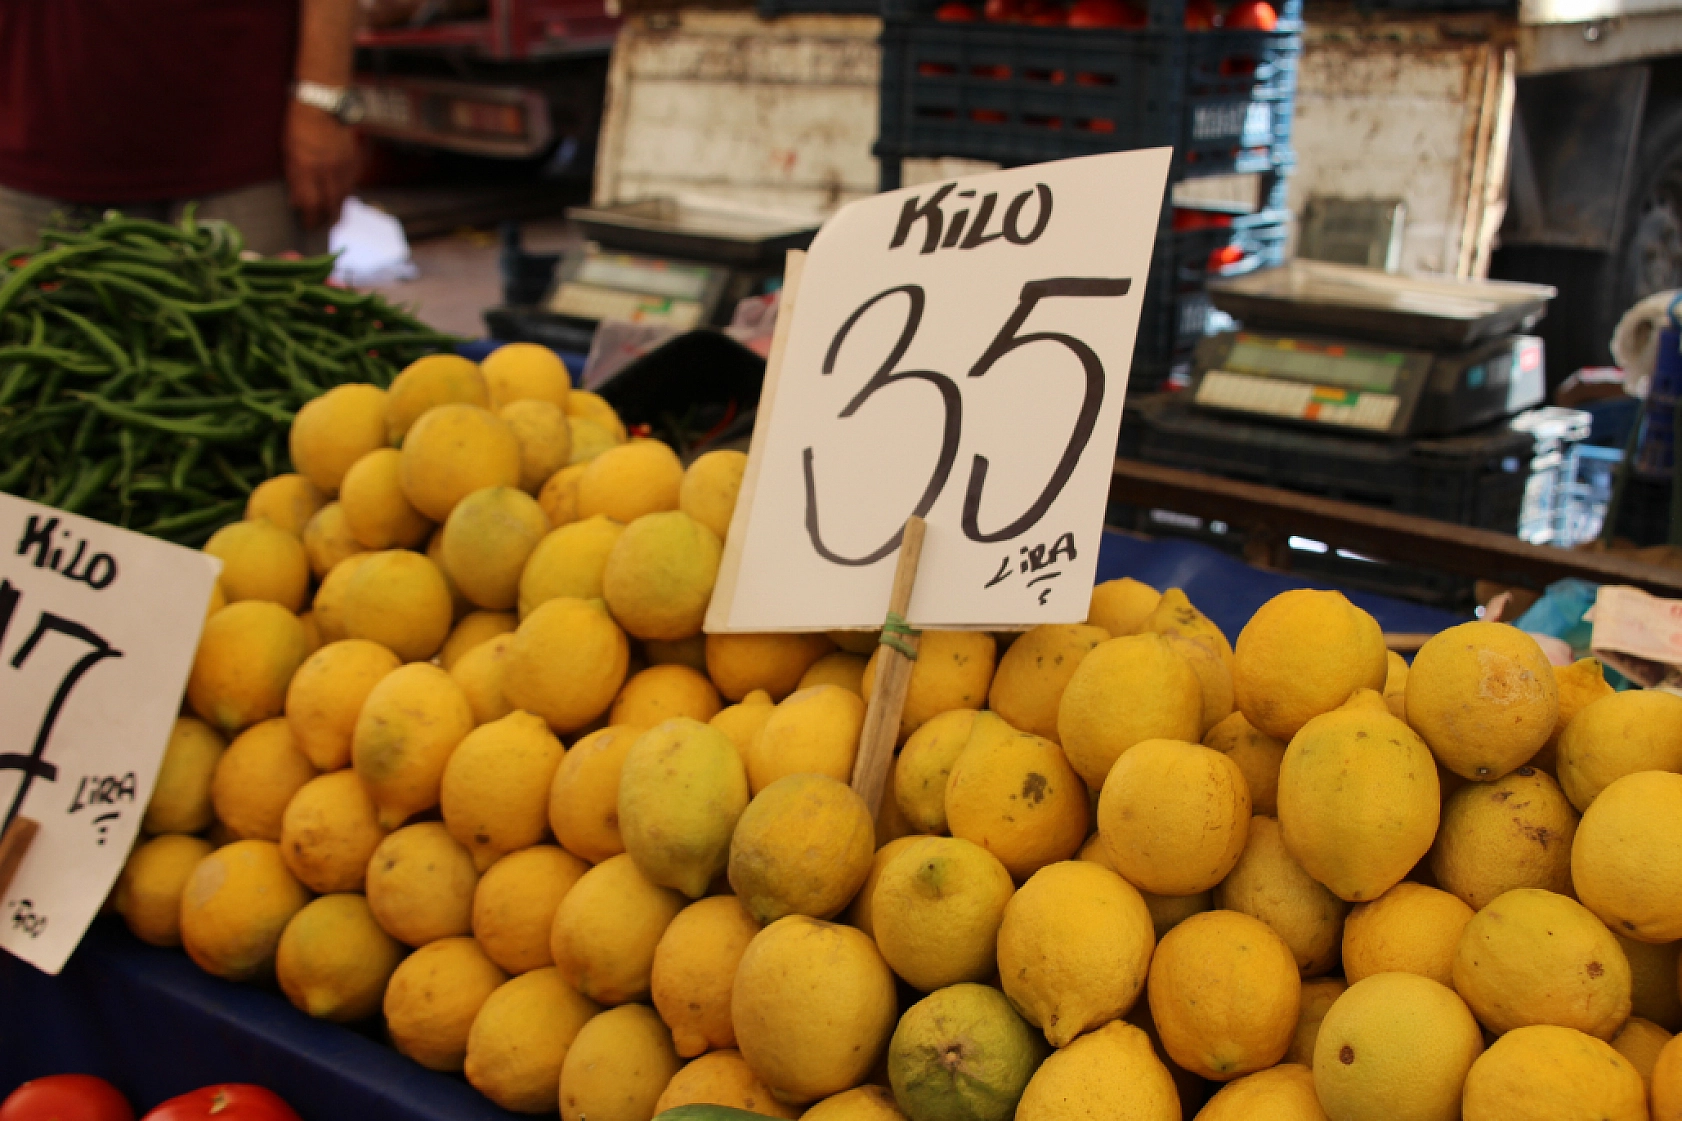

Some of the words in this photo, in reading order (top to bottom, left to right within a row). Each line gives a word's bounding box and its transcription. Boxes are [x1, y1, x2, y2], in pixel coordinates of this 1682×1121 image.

[889, 182, 1053, 254] KiLO
[803, 277, 1132, 566] 35
[17, 514, 117, 590] KiLO
[984, 531, 1077, 589] LiRA
